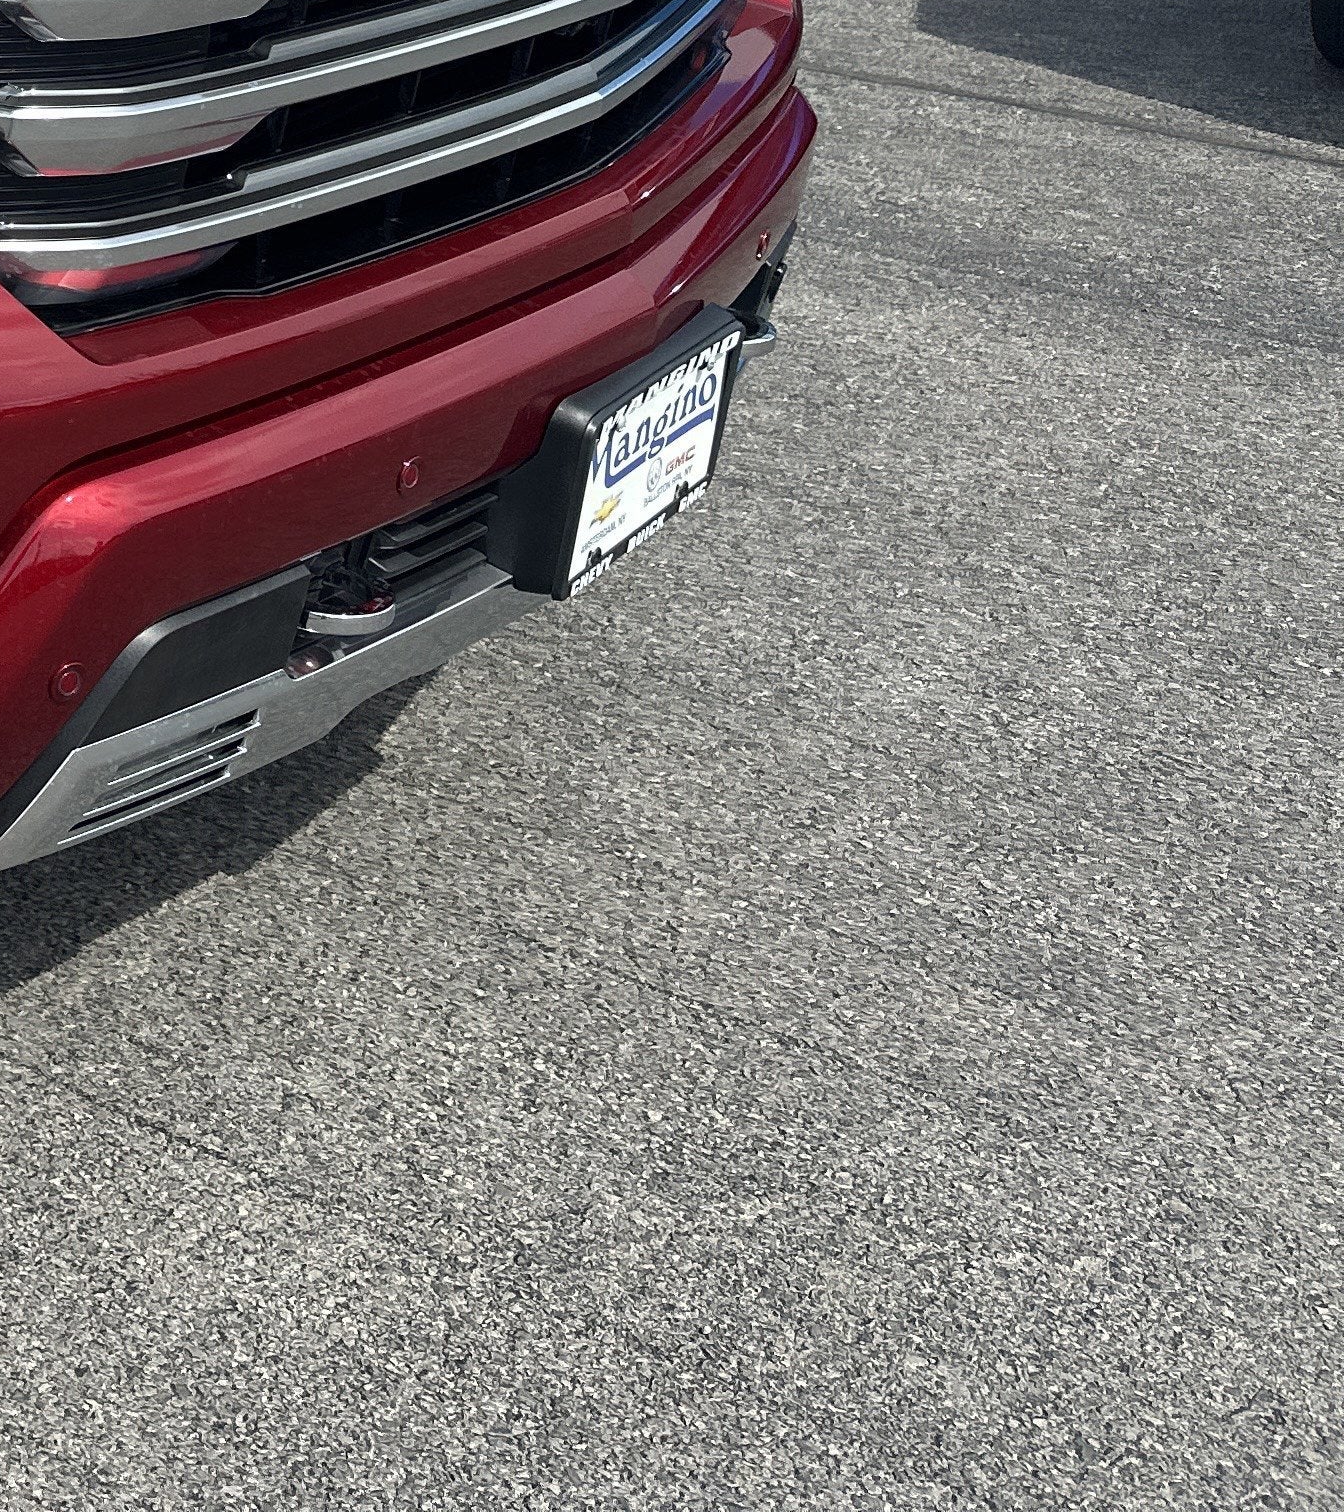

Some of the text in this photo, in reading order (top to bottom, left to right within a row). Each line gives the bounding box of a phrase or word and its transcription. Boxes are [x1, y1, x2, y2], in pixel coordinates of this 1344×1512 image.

[590, 373, 717, 488] Mangino
[665, 444, 696, 476] GMC
[570, 481, 708, 597] CHEVY BUICK GMC
